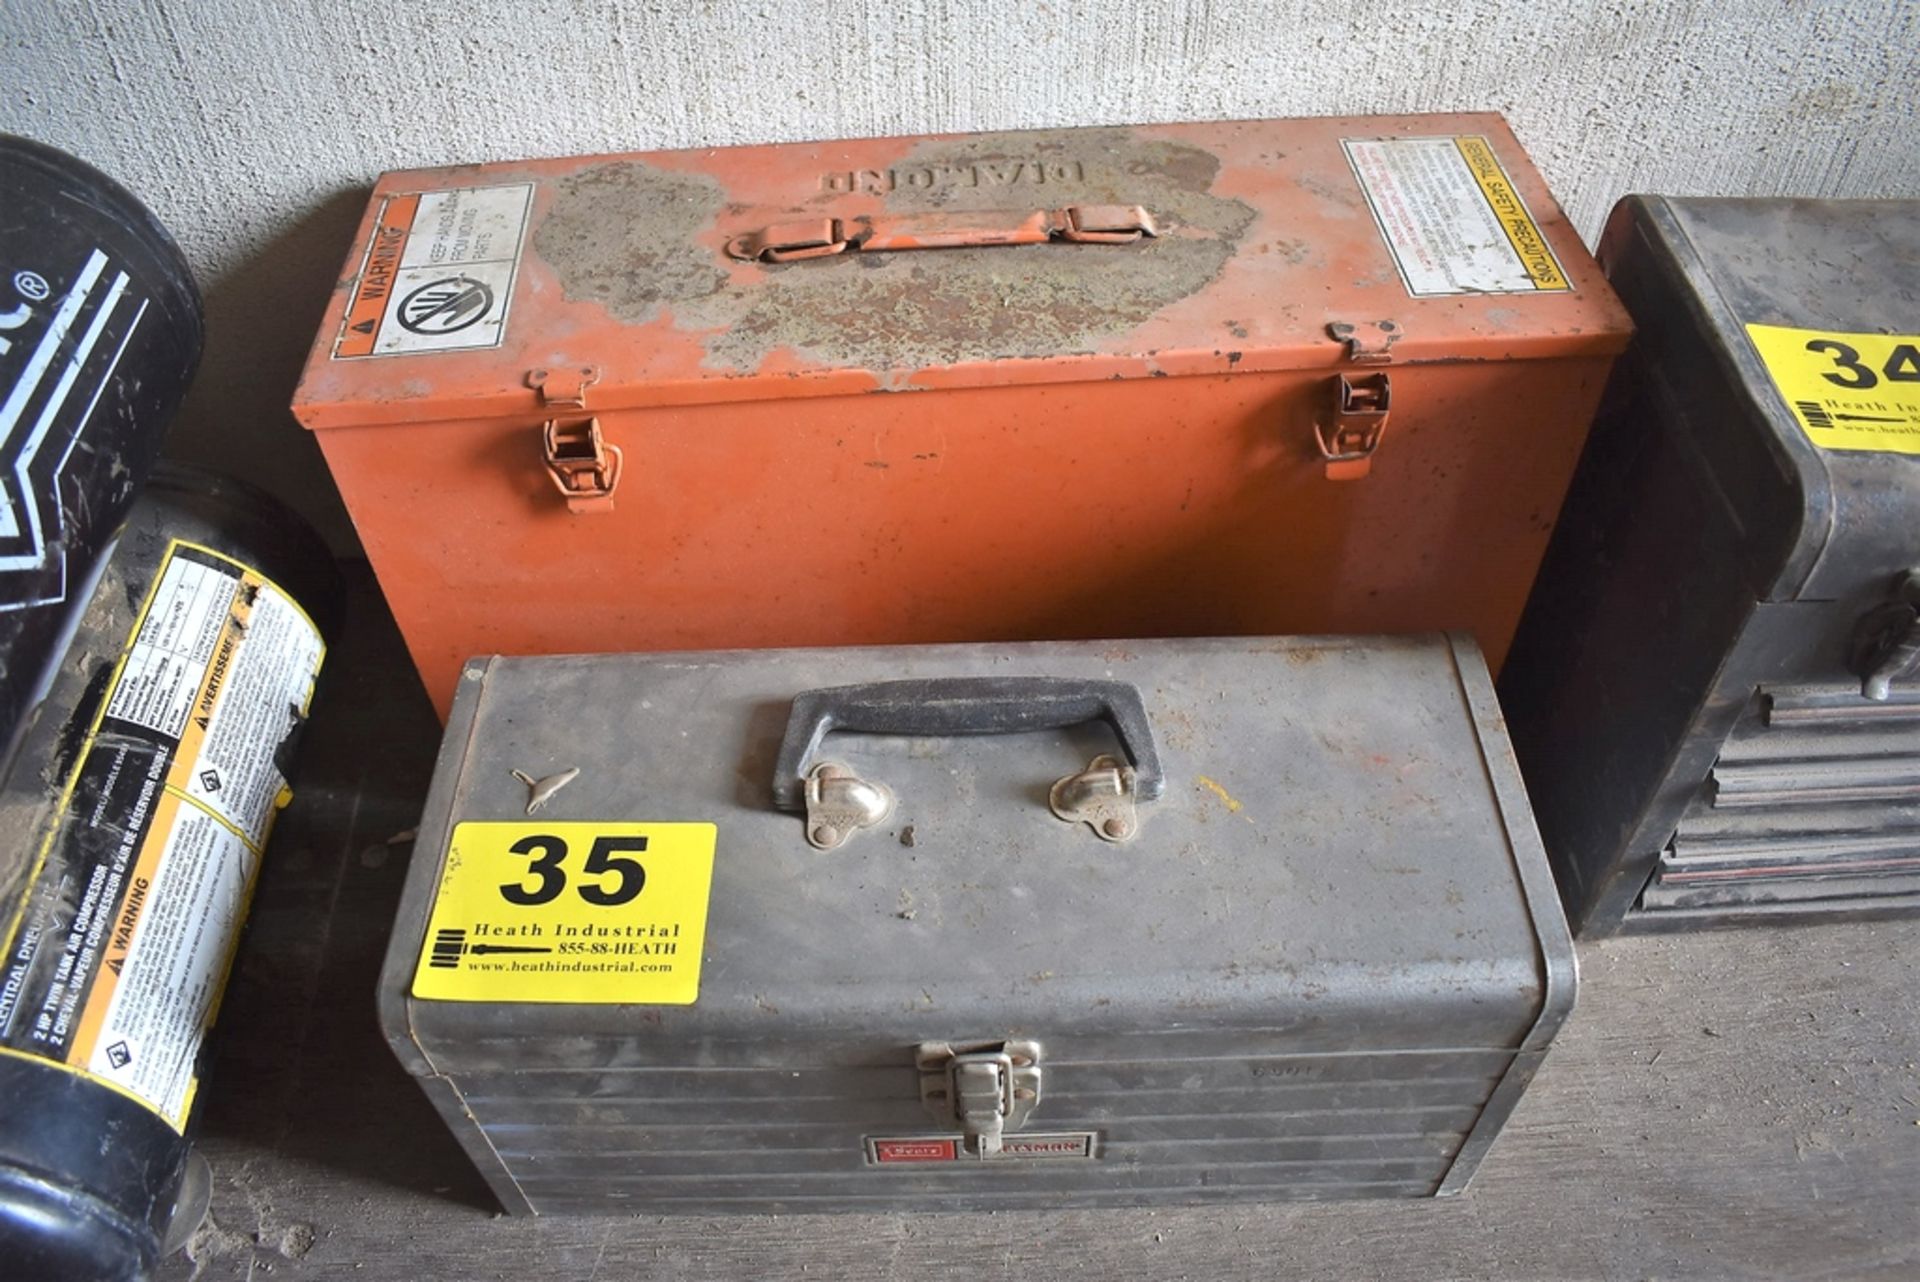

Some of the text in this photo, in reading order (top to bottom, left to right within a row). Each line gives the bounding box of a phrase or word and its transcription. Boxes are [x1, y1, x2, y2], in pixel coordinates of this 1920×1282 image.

[817, 160, 1086, 194] DIAMOND
[1487, 182, 1515, 215] SAFETY
[1509, 217, 1557, 283] PRECAUTIONS
[361, 228, 403, 300] WARNING
[1825, 399, 1887, 412] Heath
[128, 778, 157, 830] RÉSERVOIR
[124, 830, 137, 845] DE
[500, 834, 649, 906] 35
[86, 872, 121, 947] COMPRESSEUR
[113, 876, 150, 952] WARNING
[474, 923, 680, 937] Heath Industrial
[32, 863, 108, 1041] 2 HP TWIN TANK AIR COMPRESSOR
[468, 960, 673, 973] www.heathindustrial.com
[558, 942, 676, 955] 855-88-HEATH
[50, 1034, 63, 1045] 2
